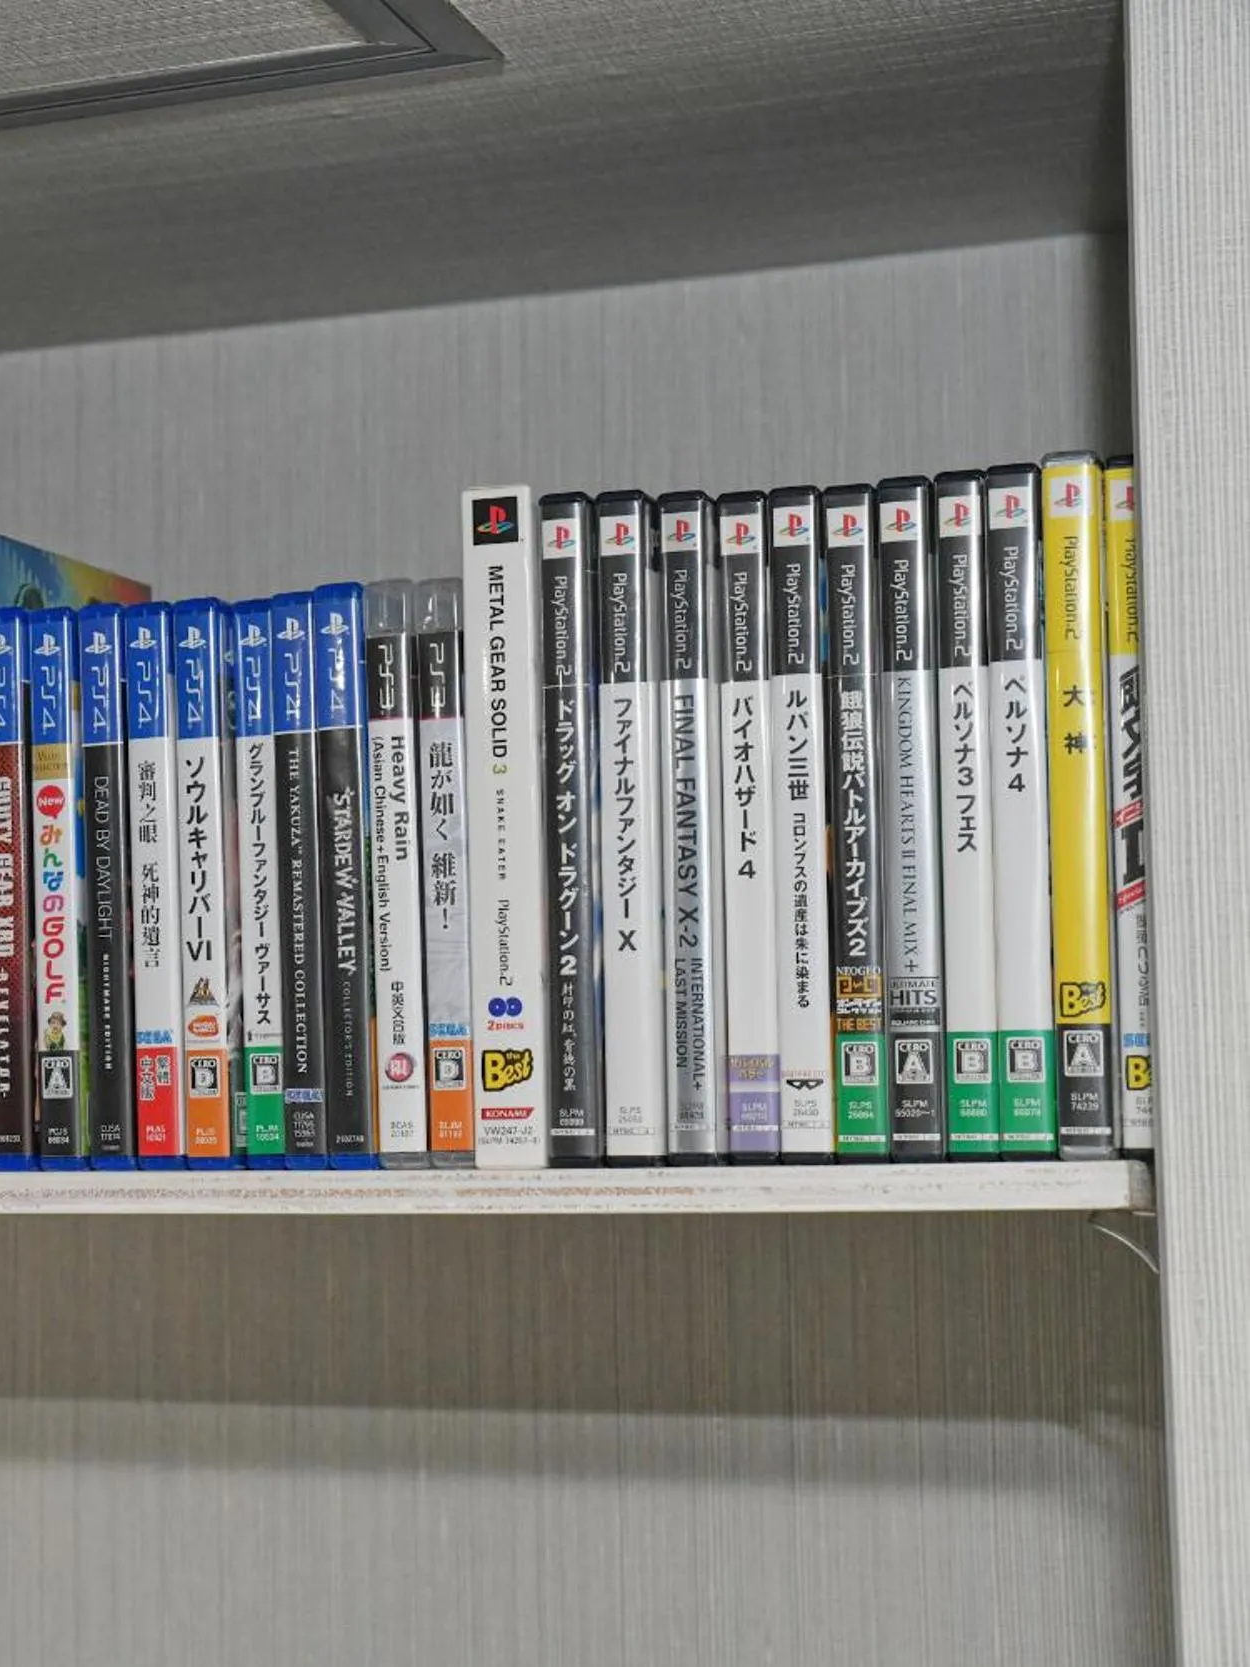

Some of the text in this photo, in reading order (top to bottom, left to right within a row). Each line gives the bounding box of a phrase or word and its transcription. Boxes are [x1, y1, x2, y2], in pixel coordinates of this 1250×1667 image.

[41, 665, 57, 734] PS4
[91, 665, 106, 734] PS4
[136, 661, 153, 728] PS4
[186, 659, 202, 729] PS4
[246, 656, 261, 726] PS4
[284, 652, 299, 720] PS4
[378, 643, 394, 709] PS3
[429, 642, 446, 711] PS3
[488, 565, 508, 775] METAL GEAR SOLID 3
[786, 690, 810, 801] ルパン三世
[897, 676, 912, 768] KINGDOM
[287, 749, 301, 780] THE
[372, 736, 387, 782] (Asian
[429, 741, 454, 840] 龍が如く
[389, 736, 409, 861] Heavy Rain
[674, 695, 699, 948] FINAL FANTASY X-2
[899, 775, 915, 845] HEARTS
[93, 776, 113, 940] DEAD BY DAYLIGHT
[495, 788, 507, 880] SNAKE EATER
[290, 859, 305, 965] REMASTERED
[333, 790, 357, 974] STARDEW VALLEY
[902, 865, 917, 916] FINAL
[378, 912, 392, 971] Version)
[293, 970, 307, 1073] COLLECTION
[674, 958, 688, 1068] LAST MISSION
[837, 1017, 882, 1031] THE BEST
[890, 989, 938, 1006] HITS
[137, 1030, 173, 1044] SEGA
[484, 1050, 532, 1091] Best
[1123, 1033, 1151, 1047] SE
[485, 1108, 527, 1118] KONAMI
